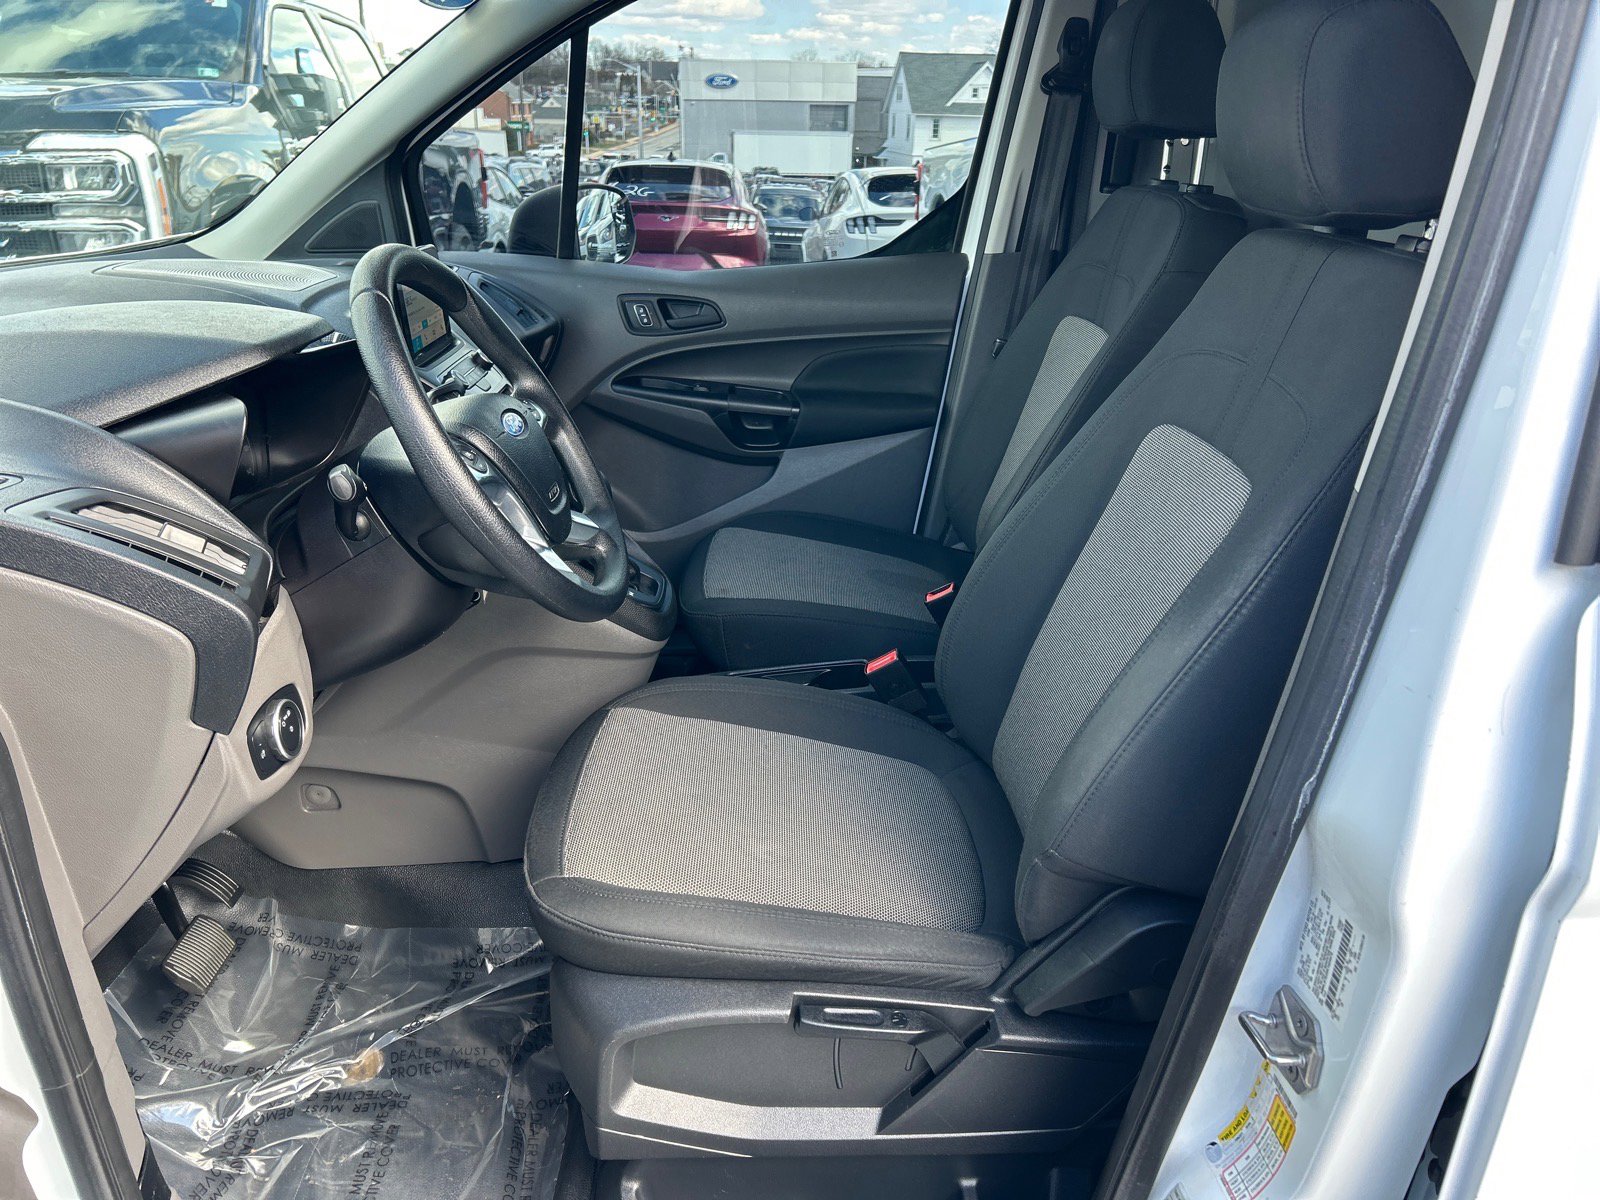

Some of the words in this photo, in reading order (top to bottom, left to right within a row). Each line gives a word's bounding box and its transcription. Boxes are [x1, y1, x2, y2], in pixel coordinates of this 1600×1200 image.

[709, 75, 734, 87] Ford
[288, 931, 362, 953] PROTECTIVE
[476, 943, 523, 954] COVER
[310, 950, 359, 966] DEALER
[161, 1000, 200, 1043] REMOVE
[139, 1036, 193, 1063] DEALER
[199, 1059, 238, 1075] MUST
[390, 1046, 441, 1064] DEALER
[451, 1047, 487, 1056] MUST
[390, 1058, 471, 1078] PROTECTIVE
[323, 1089, 412, 1101] PROTECTIVE
[303, 1104, 343, 1114] MUST
[353, 1100, 408, 1113] DEALER
[349, 1162, 370, 1195] MUST
[362, 1112, 389, 1159] REMOVE
[377, 1124, 401, 1167] COVER
[506, 1112, 526, 1181] PROTECTIVE
[521, 1161, 537, 1191] MUST
